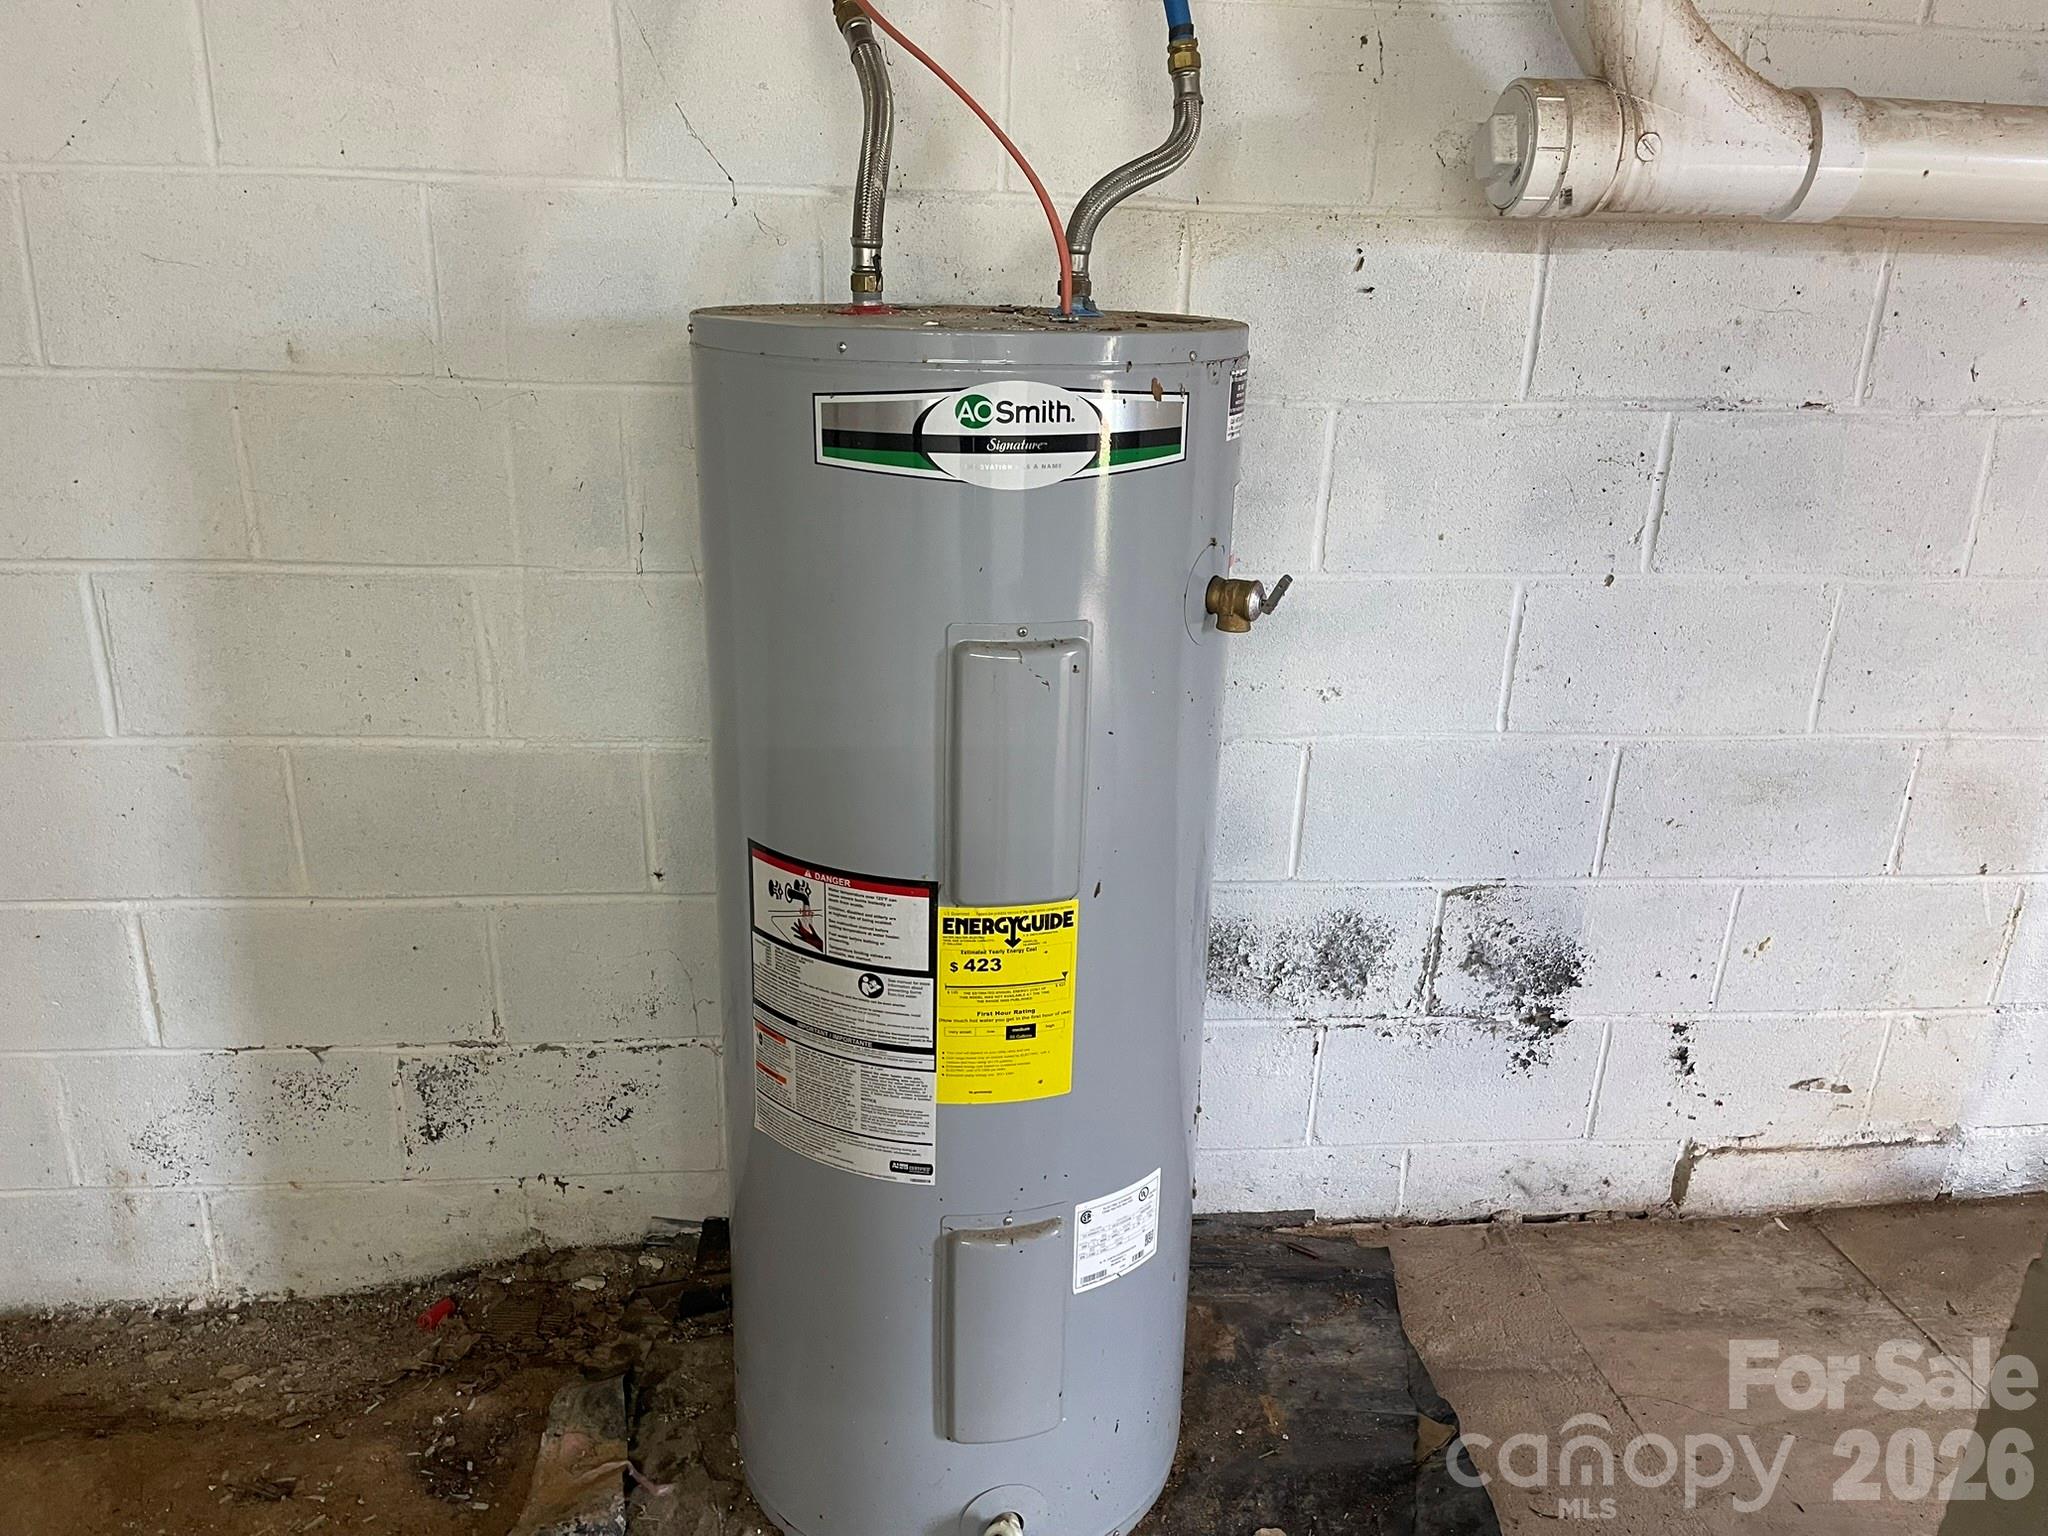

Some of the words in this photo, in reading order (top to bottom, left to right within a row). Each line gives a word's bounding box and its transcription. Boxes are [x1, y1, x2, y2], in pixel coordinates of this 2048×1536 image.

[814, 872, 852, 888] DANGER
[943, 910, 1074, 934] ENERGYGUIDE
[950, 962, 958, 972] $
[964, 958, 1002, 972] 423
